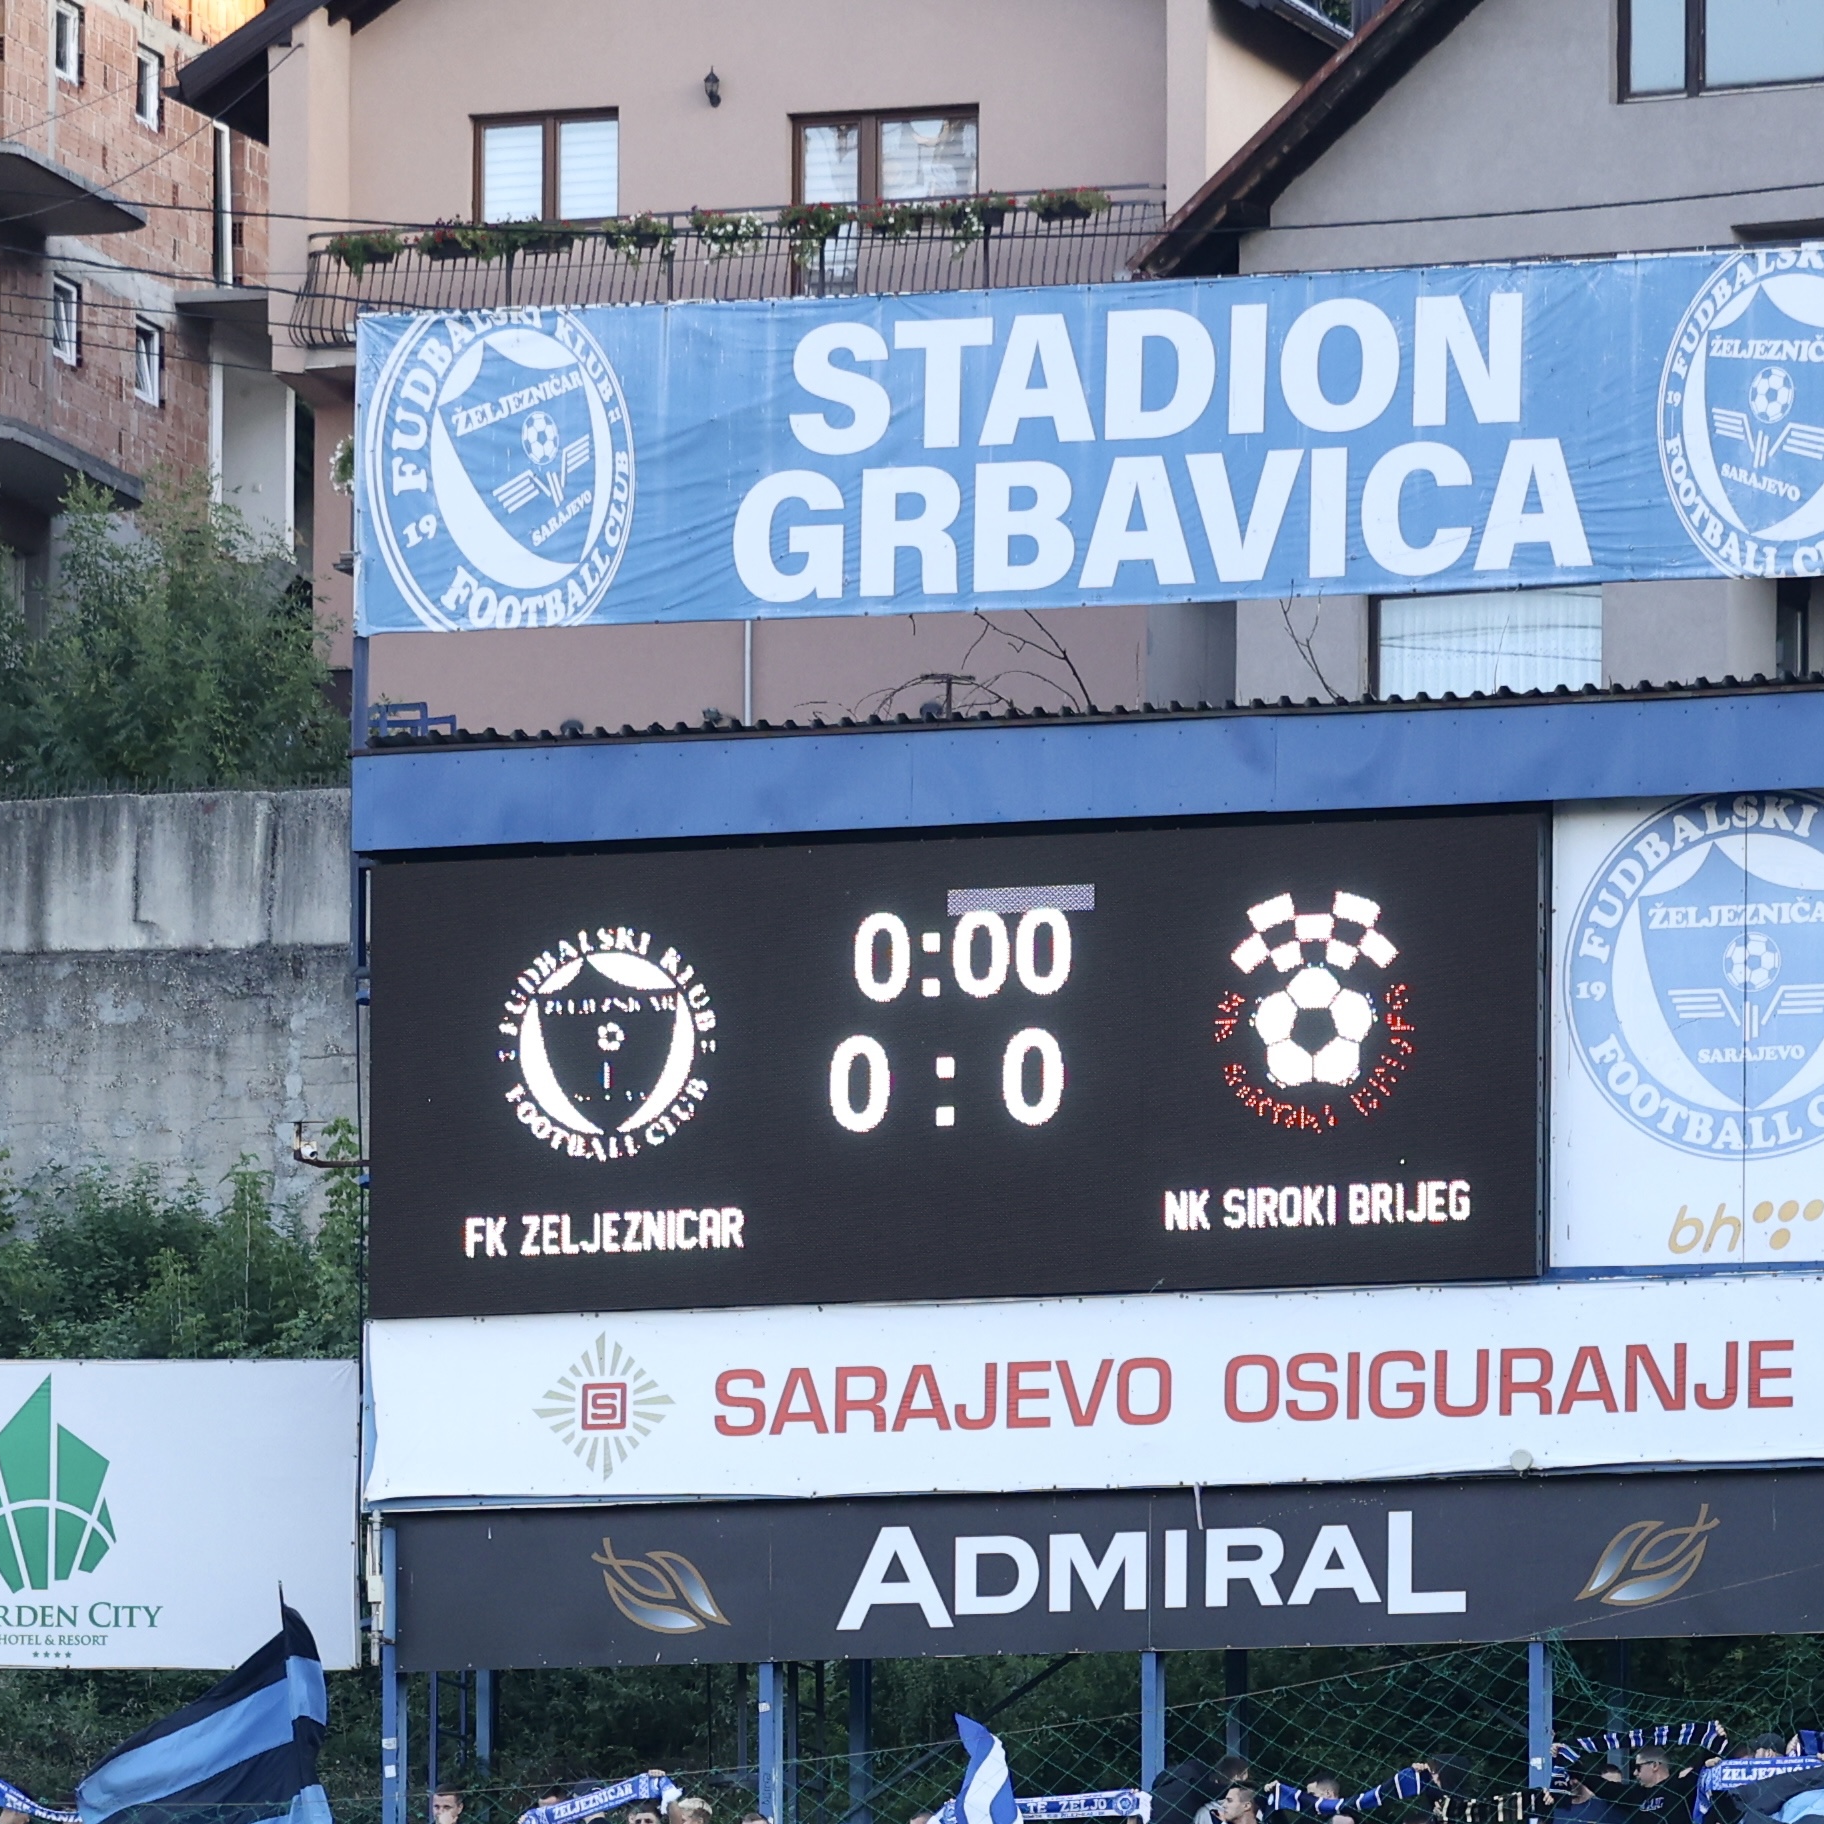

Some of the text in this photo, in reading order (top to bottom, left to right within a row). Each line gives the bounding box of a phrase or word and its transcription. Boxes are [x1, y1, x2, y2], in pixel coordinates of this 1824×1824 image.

[554, 316, 614, 404] KLUB
[791, 293, 1526, 456] STADION
[451, 371, 583, 437] ŽELJEZNIČAR
[531, 489, 593, 548] SARAJEVO
[1665, 433, 1785, 577] FOOTBALL
[1720, 462, 1801, 502] SARAJEVO
[402, 514, 438, 549] 19
[440, 450, 631, 630] FOOTBALL CLUB
[733, 441, 1591, 602] GRBAVICA
[1579, 795, 1819, 965] FUDBALSKI
[853, 907, 1073, 1003] 0:00
[1576, 981, 1608, 1001] 19
[1588, 1032, 1803, 1150] FOOTBALL
[1697, 1044, 1806, 1065] SARAJEVO
[464, 1206, 746, 1259] FK ZELJEZNICAR
[1164, 1179, 1471, 1232] NK SIROKI BRIJEG
[713, 1339, 1797, 1439] SARAJEVO OSIGURANJE
[836, 1509, 1468, 1633] ADMIRAL
[58, 1634, 109, 1646] RESORT
[88, 1601, 164, 1628] CITY
